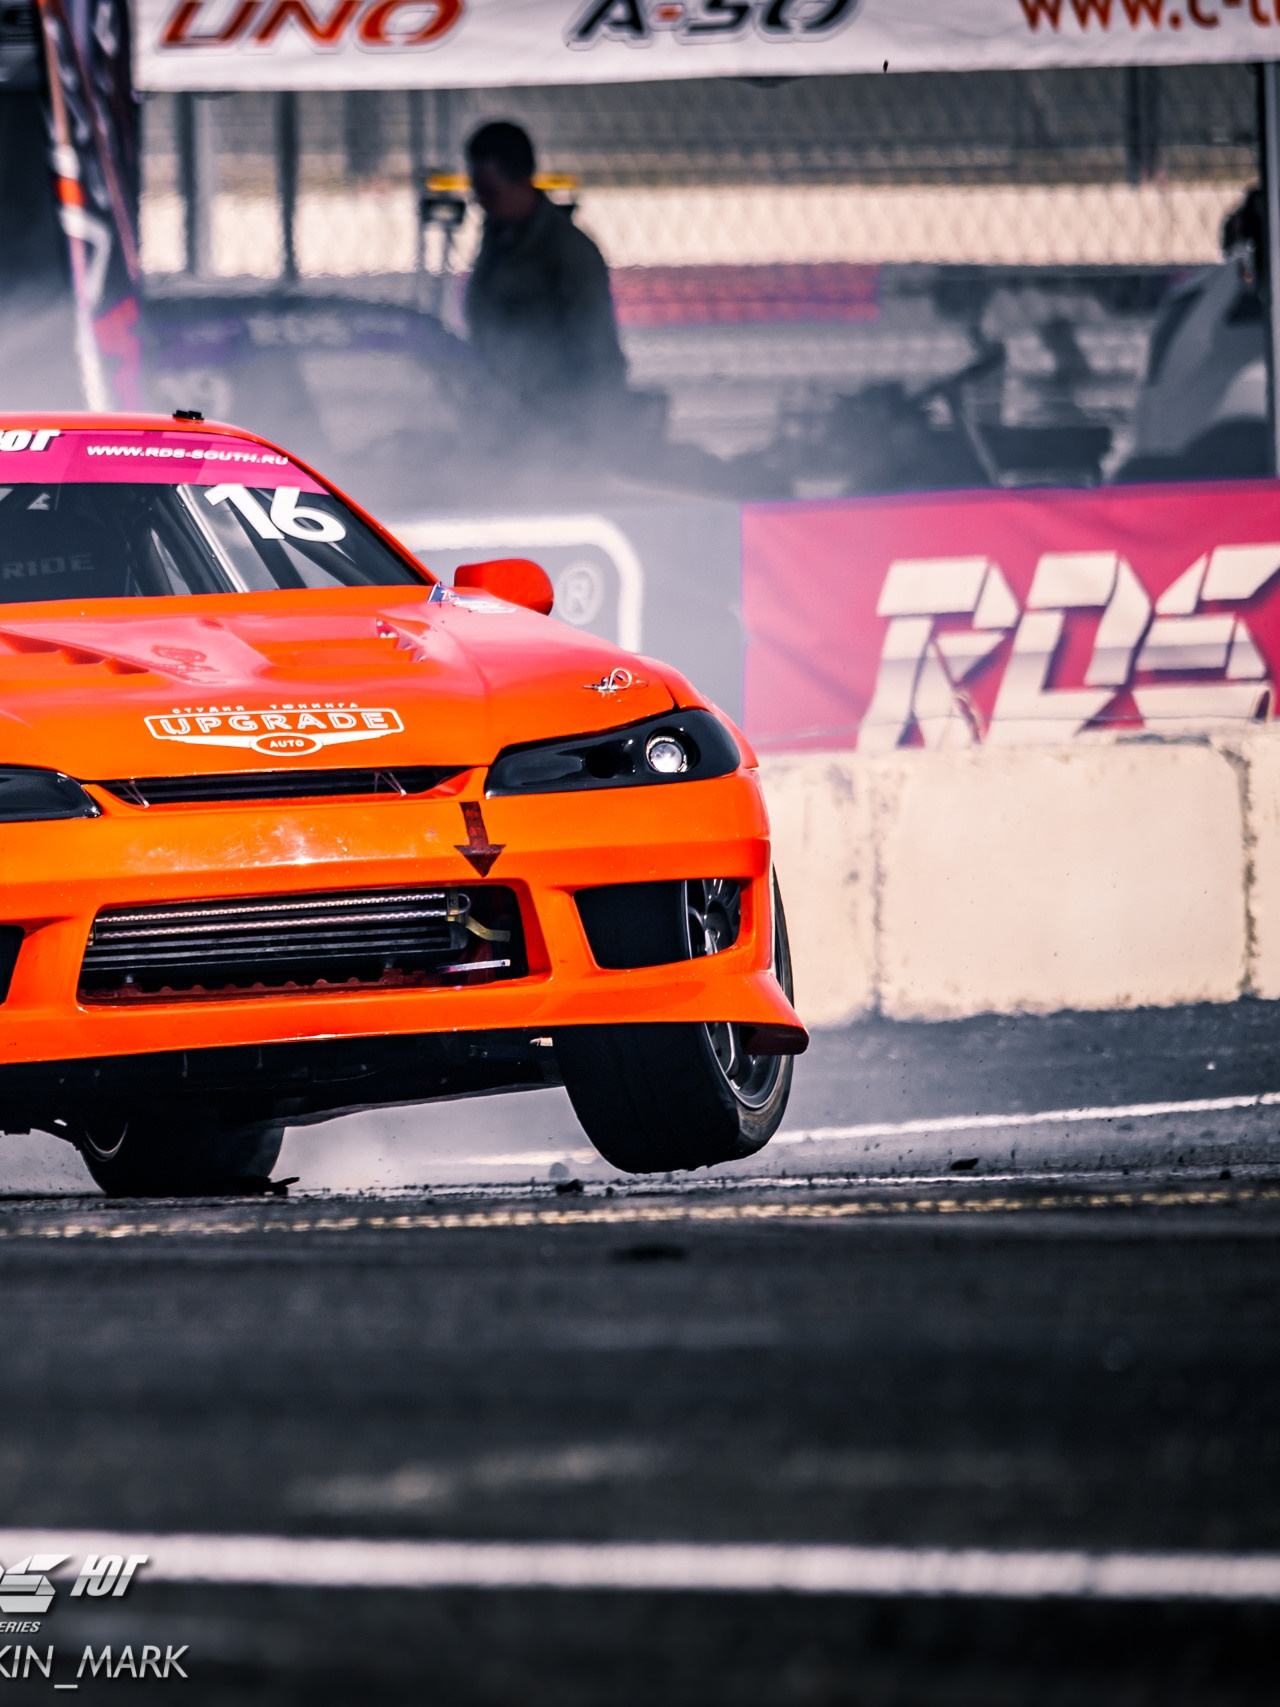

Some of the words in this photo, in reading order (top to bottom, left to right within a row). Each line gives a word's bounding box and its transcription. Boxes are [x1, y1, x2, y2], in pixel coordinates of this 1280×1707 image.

[158, 0, 466, 50] UNO
[204, 483, 347, 542] 16
[857, 542, 1280, 750] RDS
[160, 712, 389, 736] UPGRADE
[269, 739, 305, 749] AUTO
